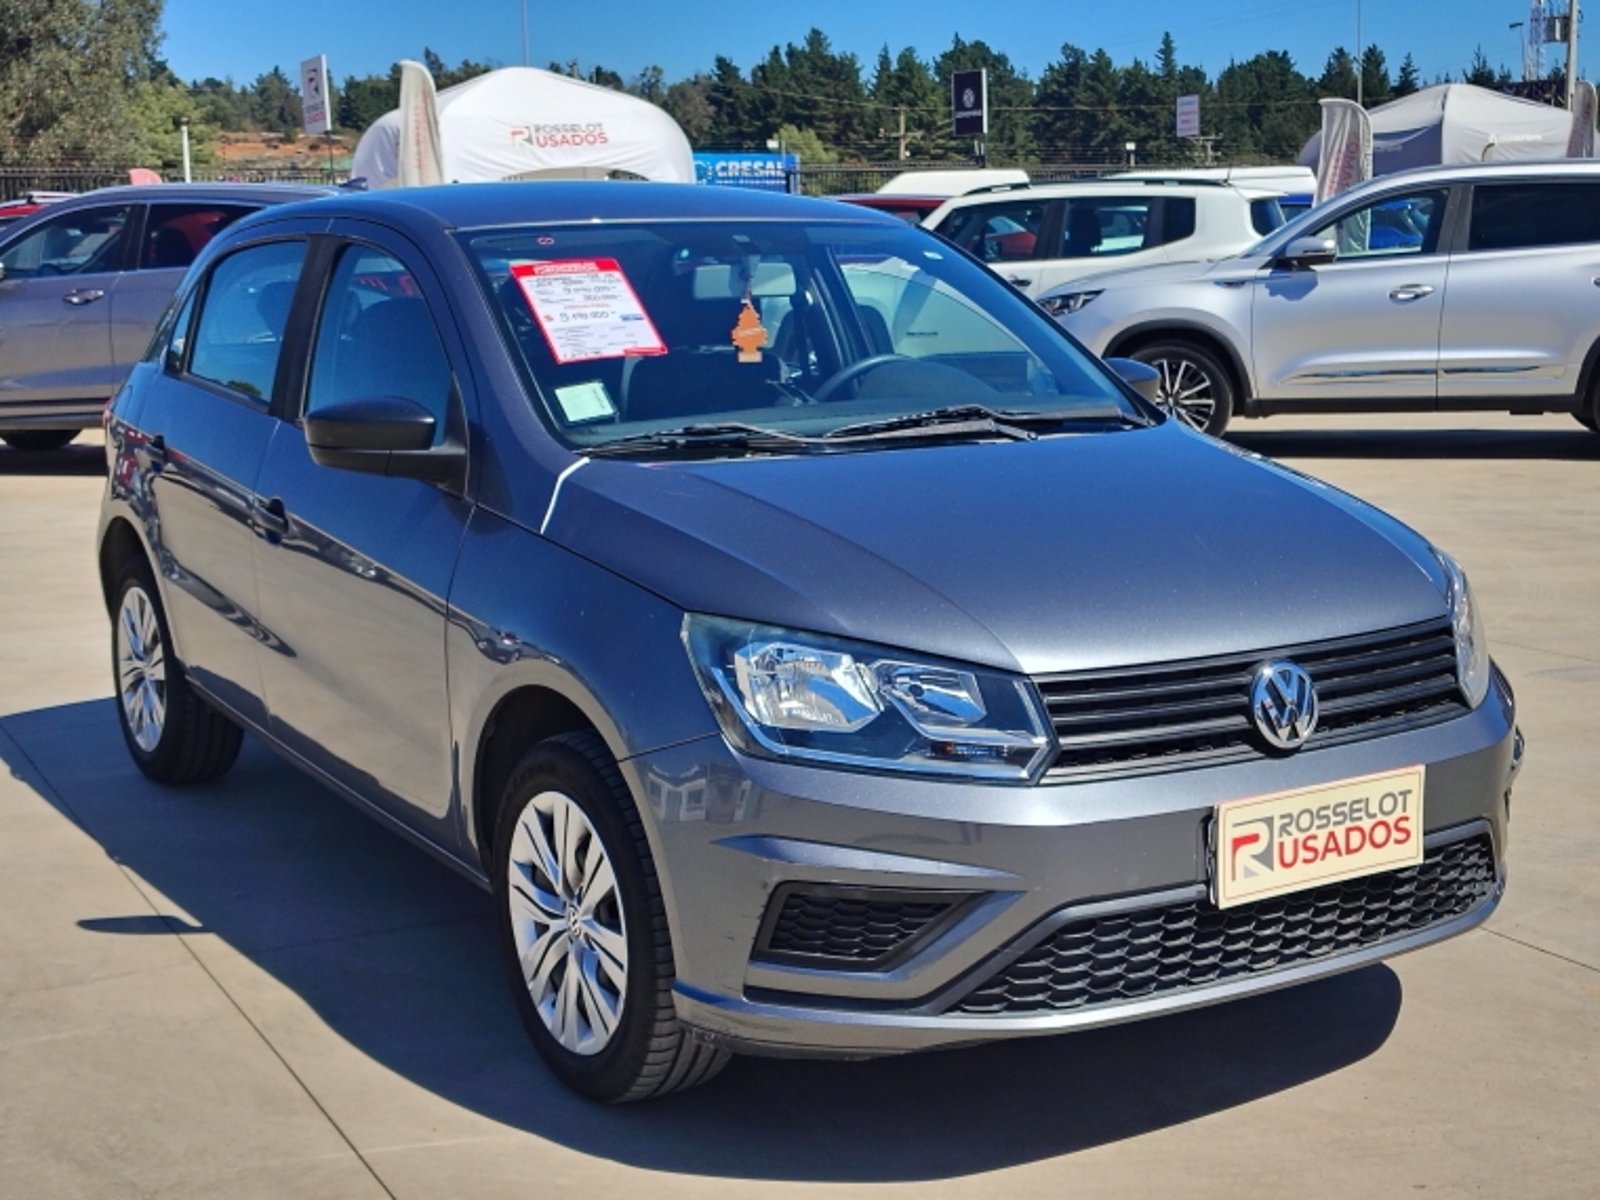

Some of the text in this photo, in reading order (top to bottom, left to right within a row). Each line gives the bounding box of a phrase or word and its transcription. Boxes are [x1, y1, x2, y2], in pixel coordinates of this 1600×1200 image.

[533, 123, 603, 135] ROSSELOT
[536, 132, 608, 148] USADOS
[1278, 789, 1412, 838] ROSSELOT
[1277, 816, 1412, 869] USADOS
